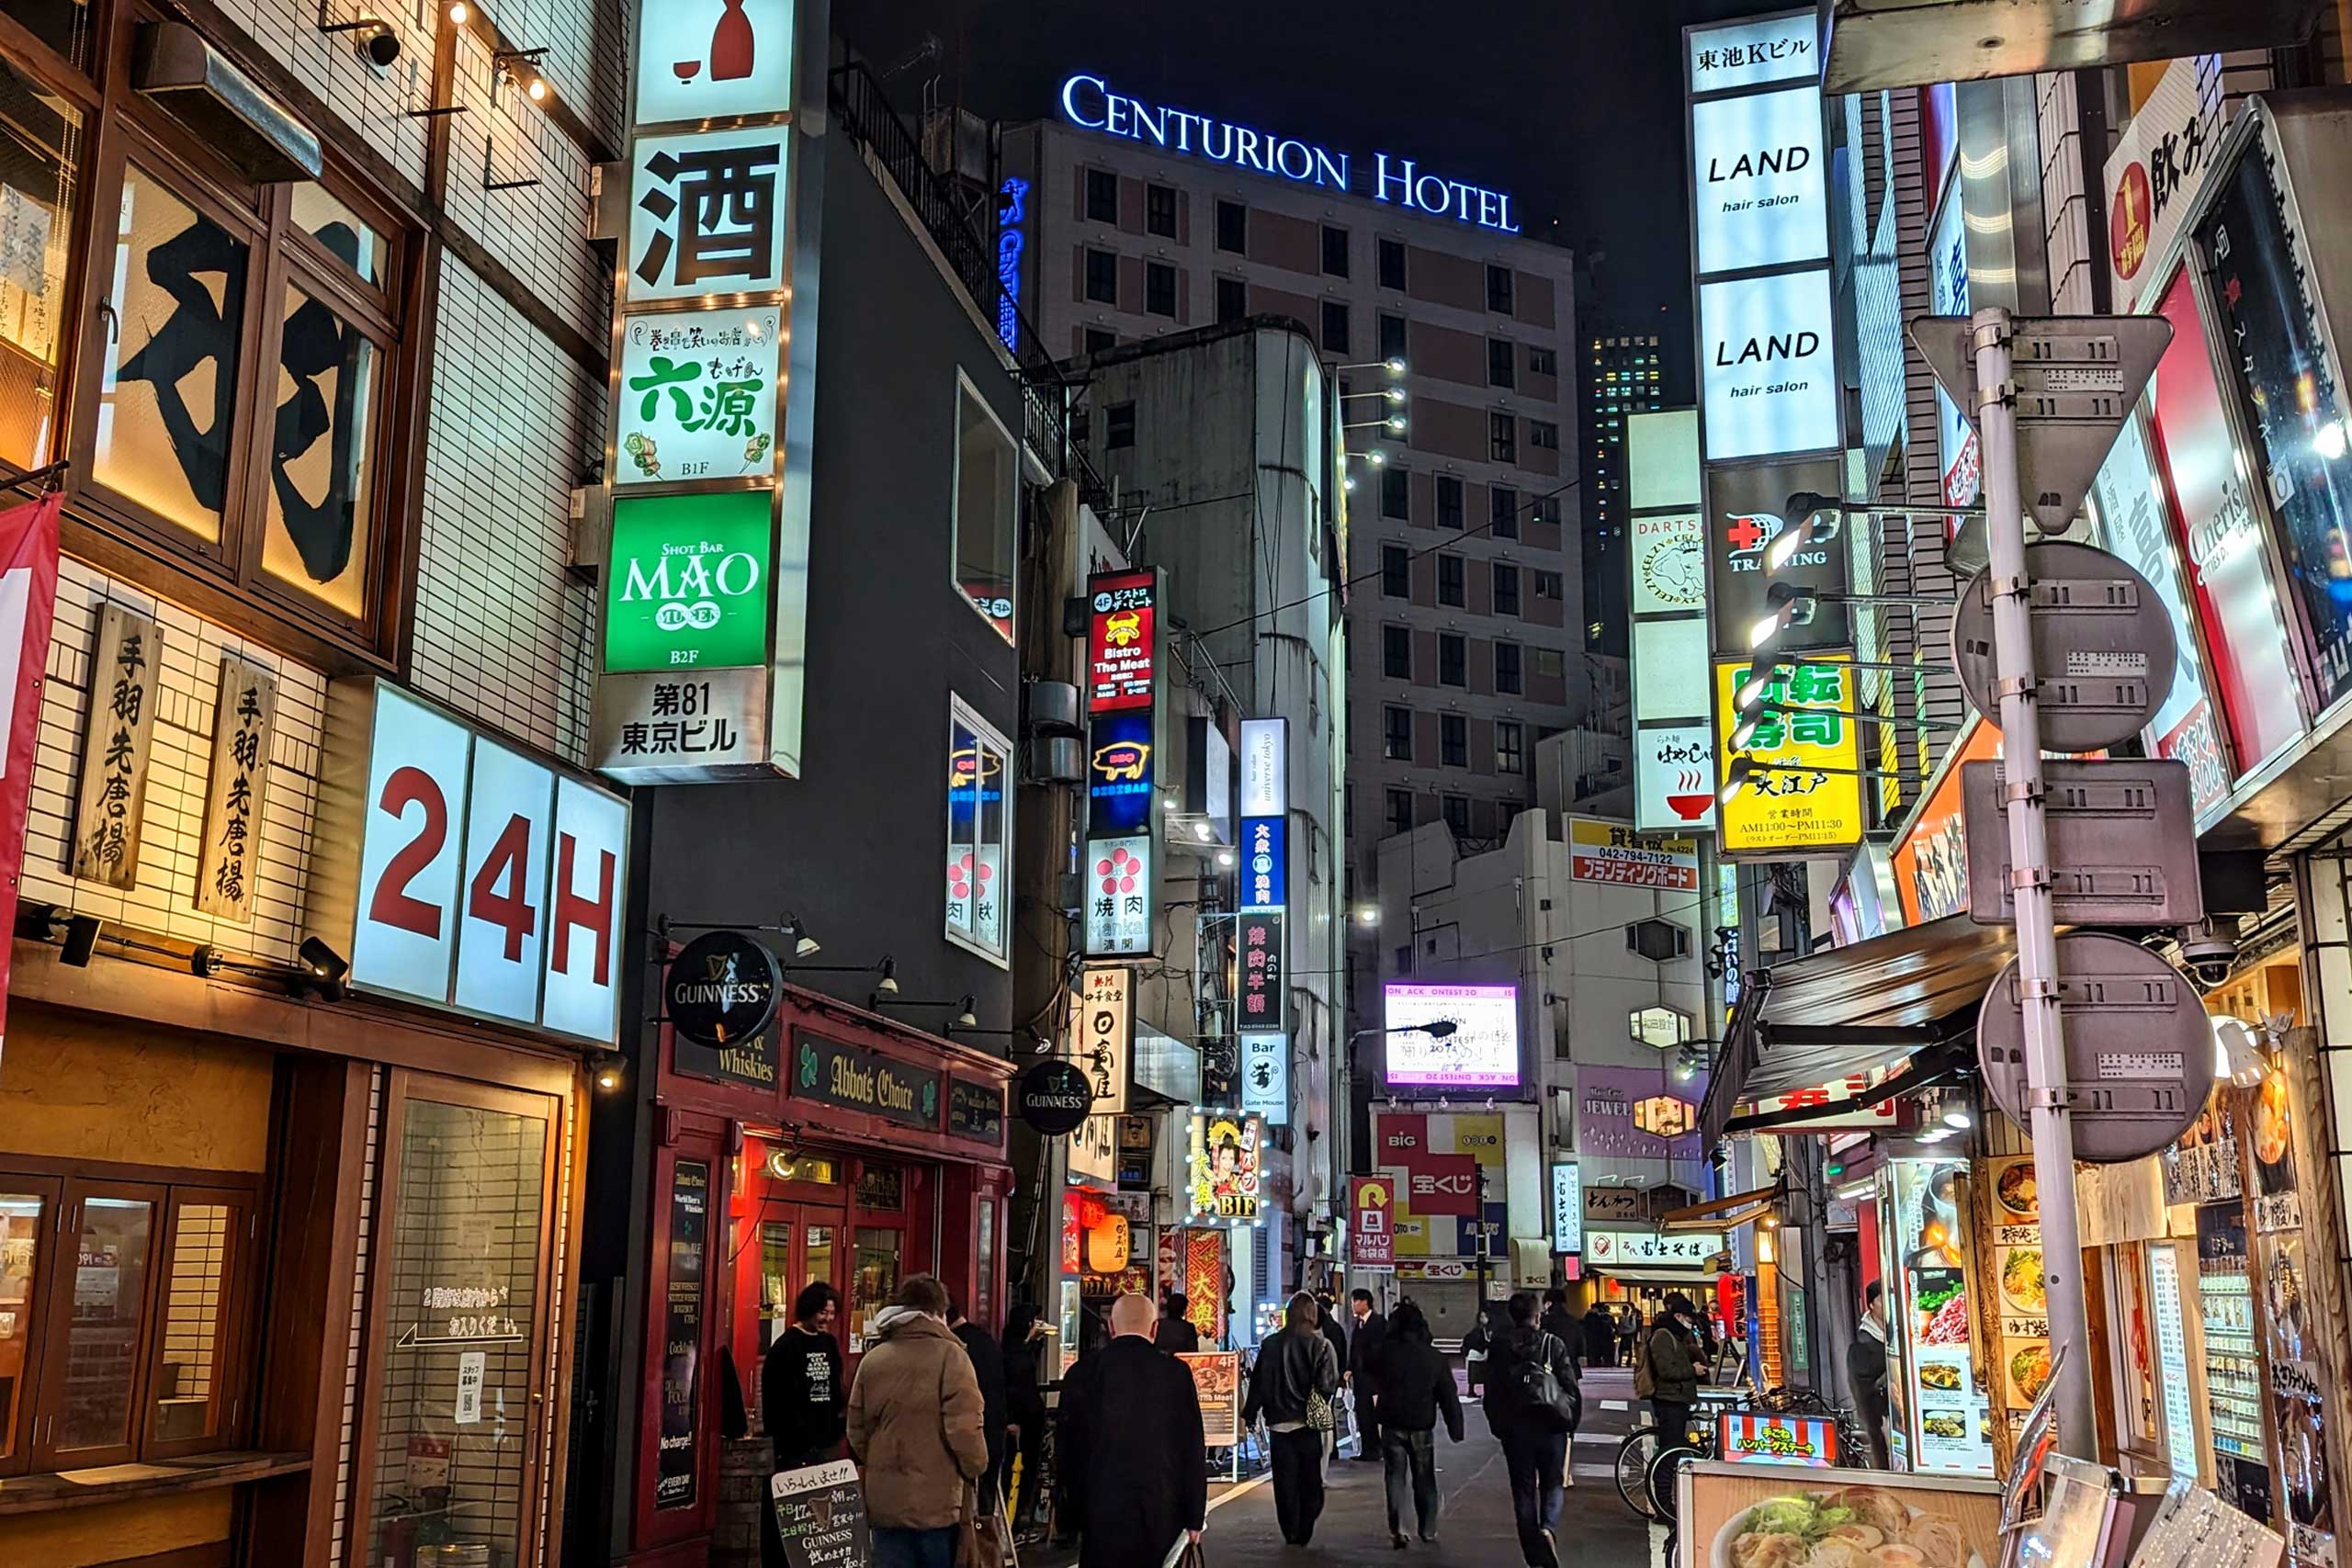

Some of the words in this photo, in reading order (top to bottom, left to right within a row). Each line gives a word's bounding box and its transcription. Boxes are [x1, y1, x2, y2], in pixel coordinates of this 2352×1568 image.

[1697, 39, 1812, 71] 東池Kビル
[1061, 74, 1349, 189] CENTURION
[1374, 152, 1520, 232] HOTEL
[1709, 147, 1809, 183] LAND
[1723, 201, 1753, 212] hair
[1758, 194, 1799, 208] salon
[635, 143, 780, 287] 酒
[1716, 332, 1819, 367] LAND
[629, 356, 763, 437] 六源
[1730, 385, 1761, 398] hair
[1766, 381, 1808, 394] salon
[682, 462, 708, 475] B1F
[1639, 520, 1696, 534] DARTS
[662, 543, 695, 556] SHOT
[699, 541, 725, 554] BAR
[1730, 552, 1826, 571] TRAING
[618, 552, 759, 602] MAO
[1096, 597, 1110, 608] 4F
[1114, 588, 1147, 599] ビストロ
[670, 649, 699, 664] B2F
[1104, 646, 1141, 660] Bistro
[1095, 662, 1117, 673] The
[1120, 658, 1150, 671] Meat
[651, 682, 710, 716] 第81
[620, 718, 737, 755] 東京ビル
[92, 634, 146, 866] 手羽先唐揚
[1263, 734, 1273, 760] tokyo
[217, 686, 262, 903] 手羽先唐揚
[1768, 808, 1813, 818] 営業時間
[1600, 847, 1673, 864] 042-794-7122
[368, 764, 616, 987] 24H
[1584, 859, 1688, 887] ブランディングボード
[1095, 896, 1142, 918] 焼肉
[675, 983, 759, 1004] GUINNESS
[1251, 1043, 1275, 1053] Bar
[718, 1049, 773, 1083] Whiskies
[831, 1055, 874, 1103] Abbot's
[877, 1069, 913, 1111] Choice
[1026, 1093, 1081, 1109] GUINNESS
[1583, 1100, 1631, 1116] JEWEL
[1193, 1149, 1215, 1207] 大奥
[1413, 1175, 1472, 1194] 宝くじ
[1220, 1196, 1255, 1216] B1F
[1589, 1191, 1634, 1208] とんかつ
[1355, 1235, 1389, 1246] マルハン
[1641, 1241, 1702, 1256] 富士そば
[1356, 1248, 1387, 1259] 池袋店
[1428, 1265, 1461, 1276] 宝くじ
[1193, 1272, 1216, 1325] 大奥
[462, 1366, 479, 1375] スタッフ
[1218, 1356, 1235, 1367] 4F
[1738, 1438, 1815, 1453] ハンバーグステーキ
[802, 1529, 853, 1550] GUINNESS
